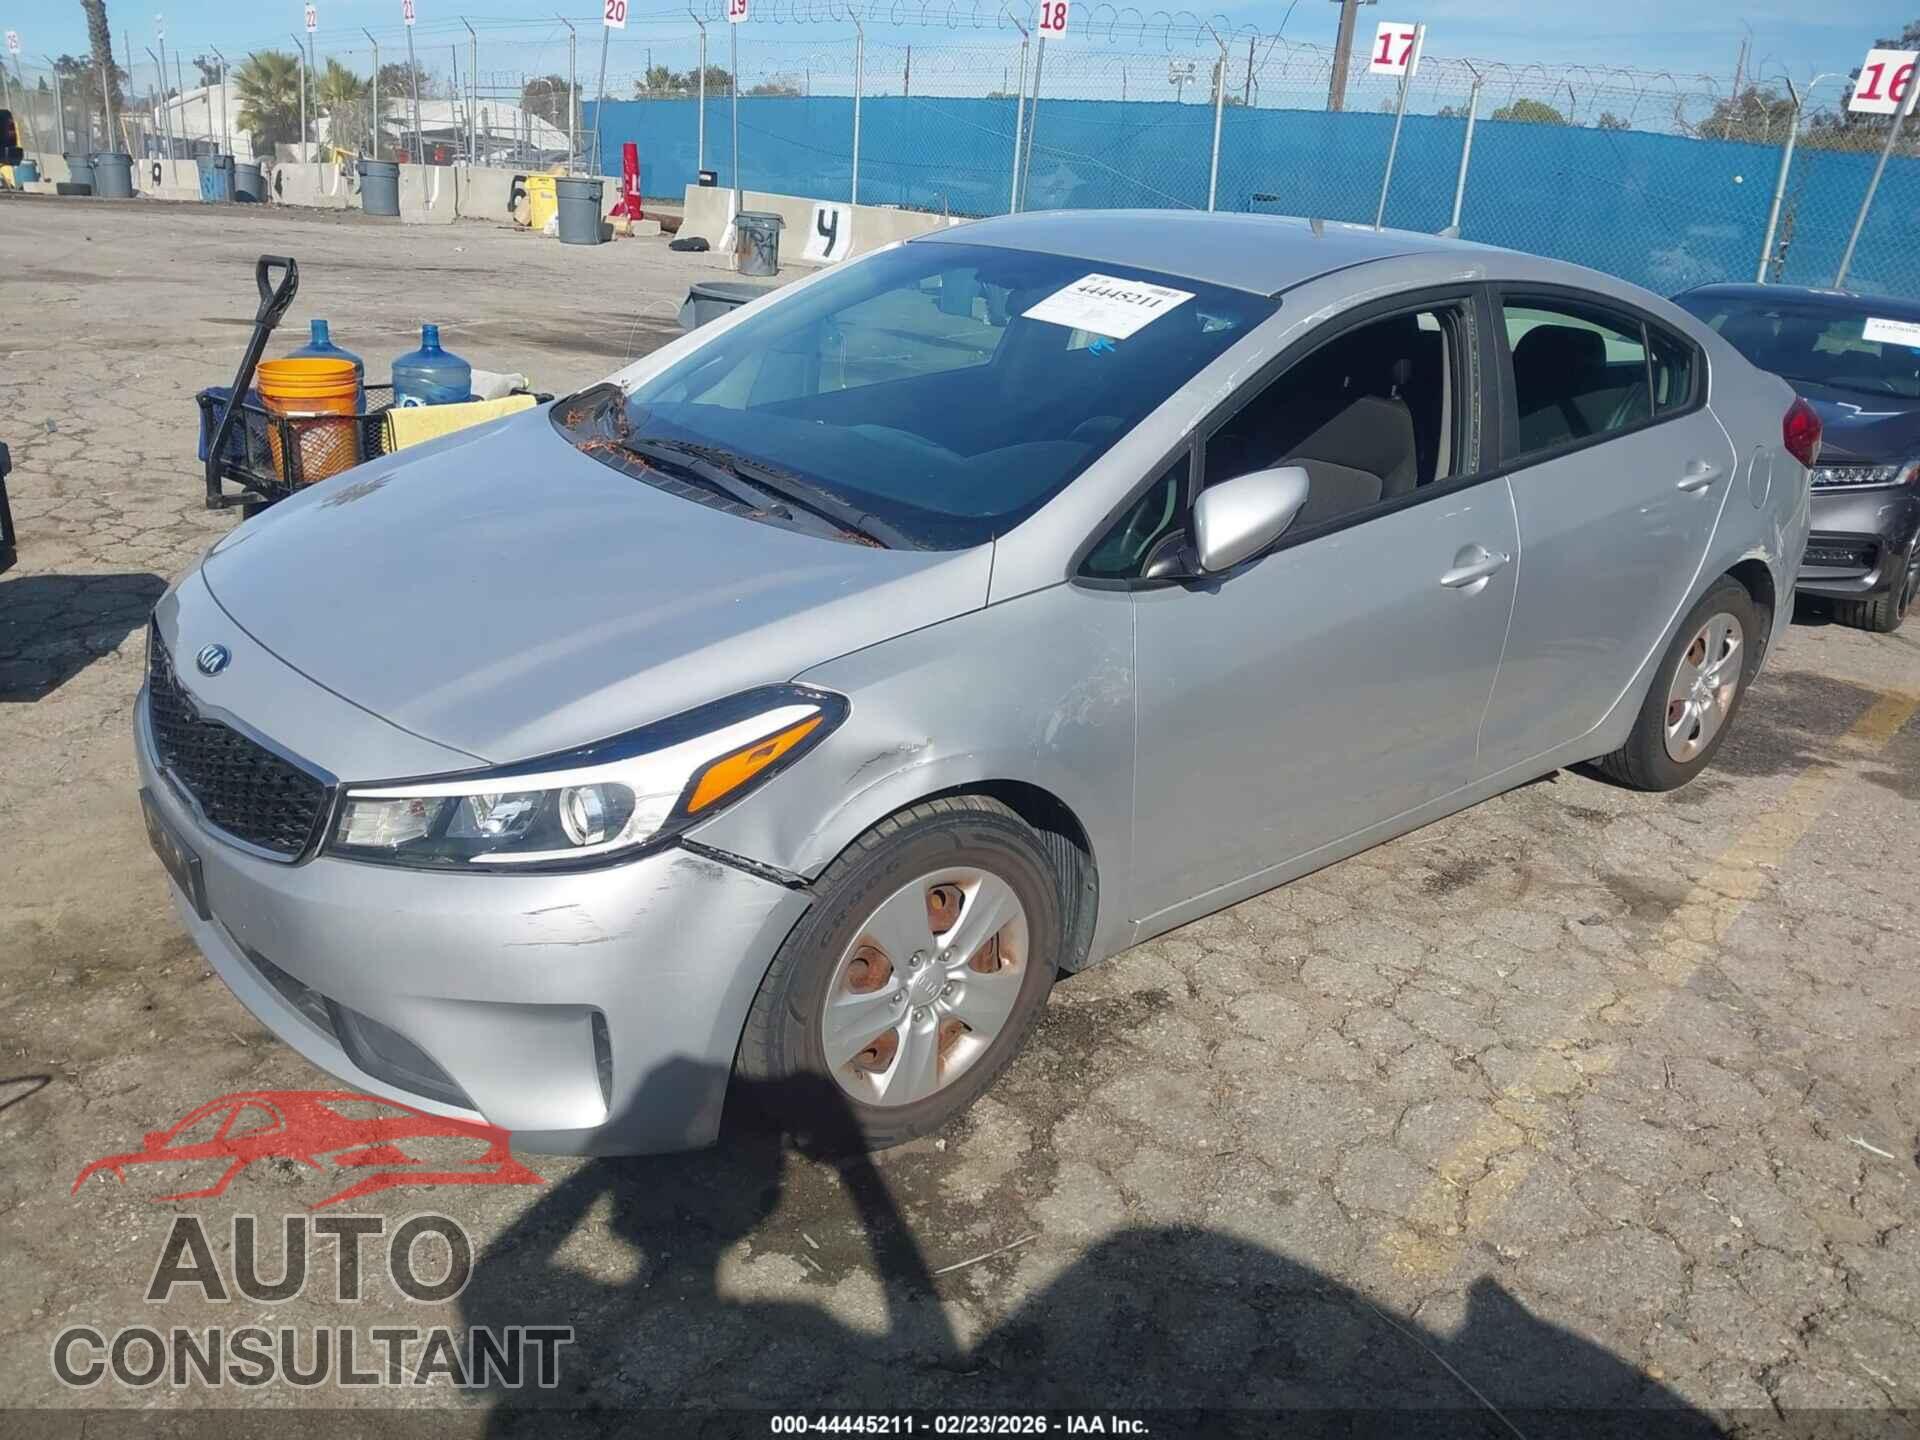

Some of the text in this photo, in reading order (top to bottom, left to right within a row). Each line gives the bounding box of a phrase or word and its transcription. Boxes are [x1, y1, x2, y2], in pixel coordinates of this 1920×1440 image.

[606, 0, 625, 22] 20
[730, 0, 747, 16] 19
[1040, 2, 1066, 31] 18
[1374, 32, 1416, 66] 17
[1857, 62, 1916, 102] 16
[817, 208, 839, 258] 4
[1077, 284, 1162, 308] 44445211
